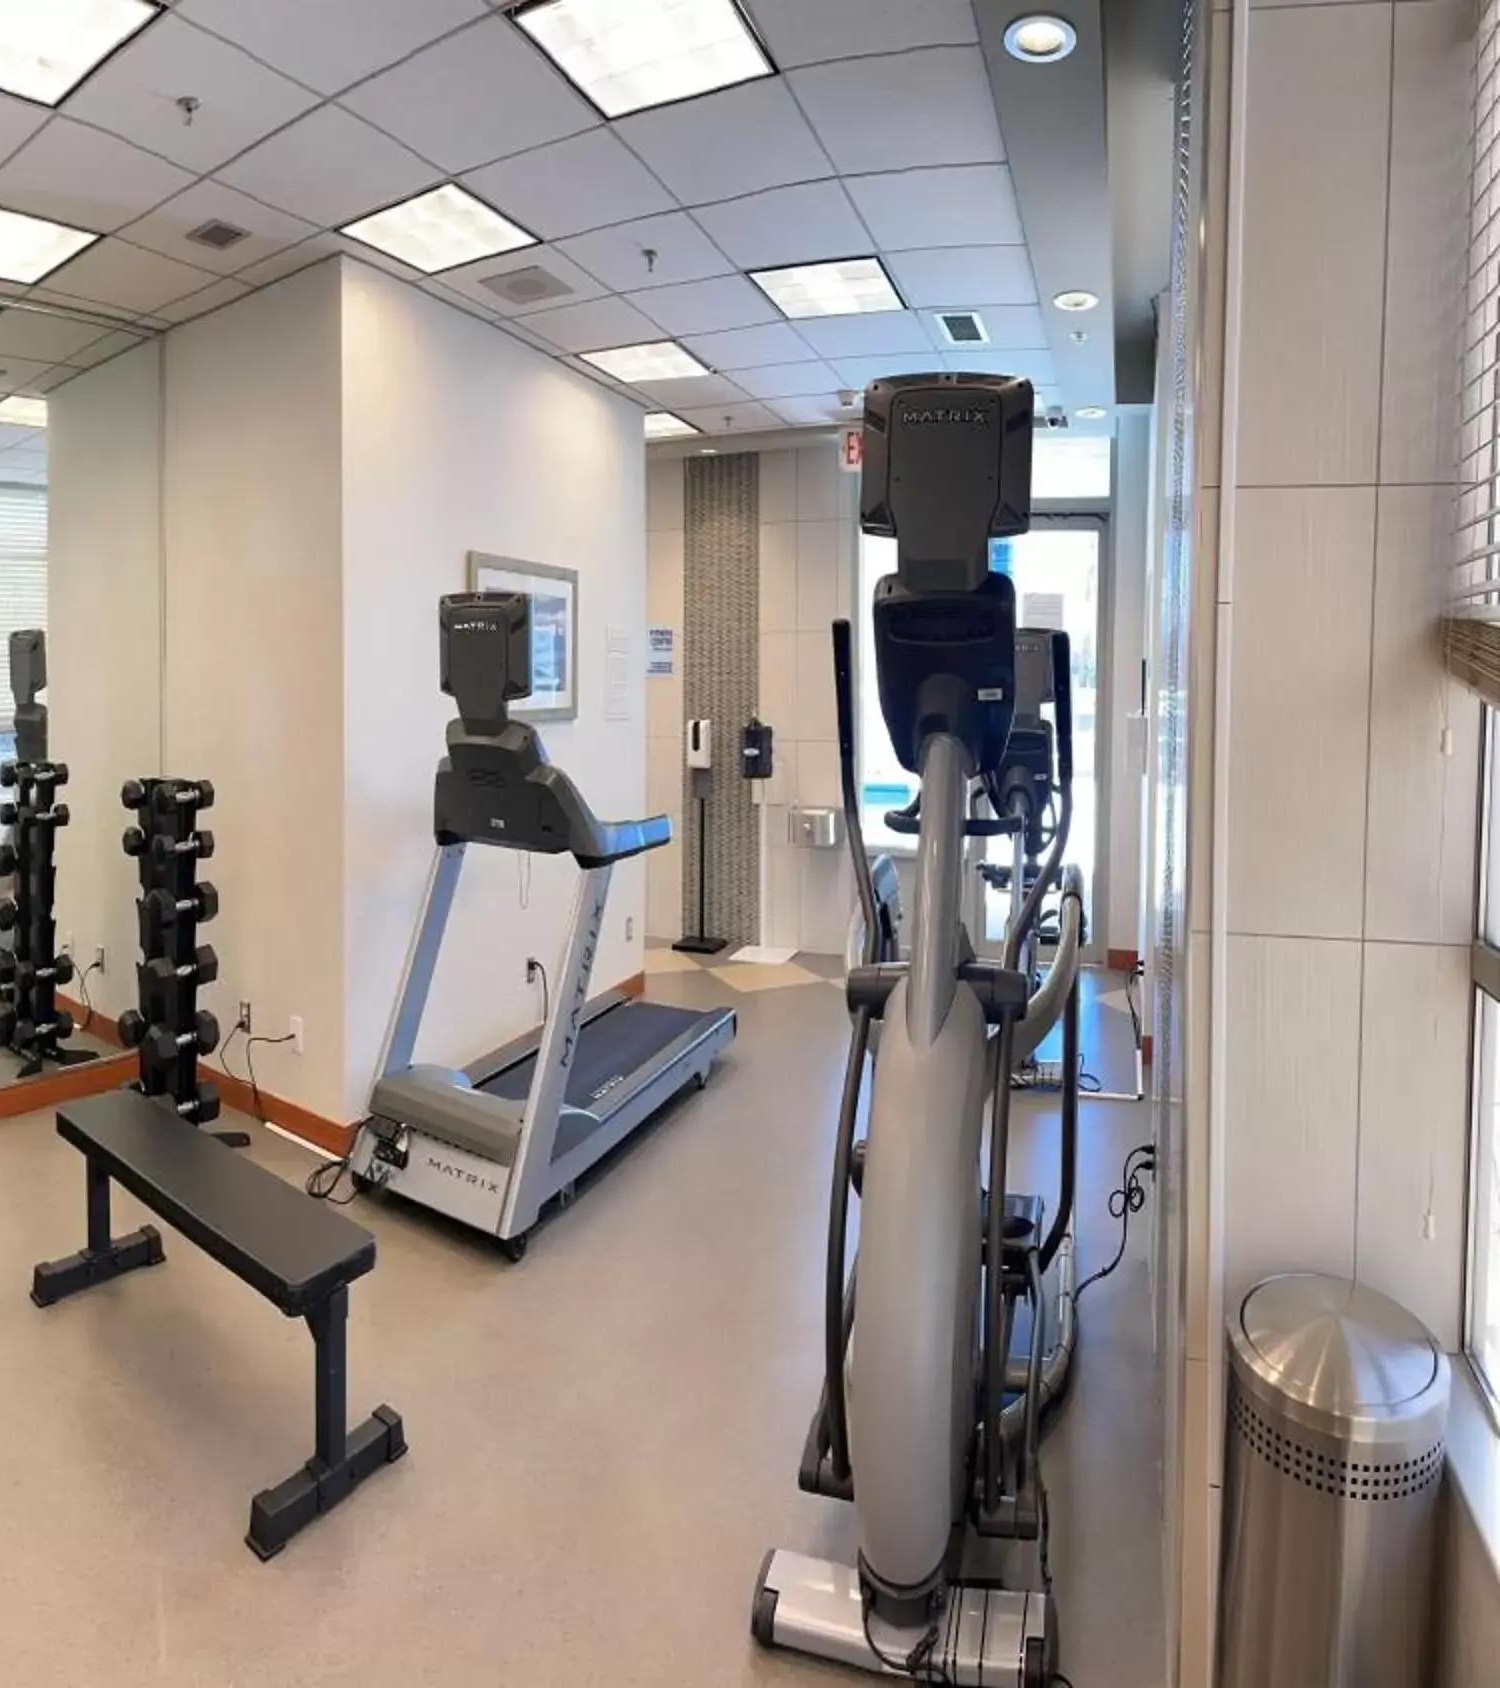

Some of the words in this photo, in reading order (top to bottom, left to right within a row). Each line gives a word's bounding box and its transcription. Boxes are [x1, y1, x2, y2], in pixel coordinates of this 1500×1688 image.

[903, 410, 986, 422] MATRIX
[846, 431, 865, 465] EX
[560, 898, 603, 1068] MATRIX
[427, 1158, 498, 1195] MATRIX
